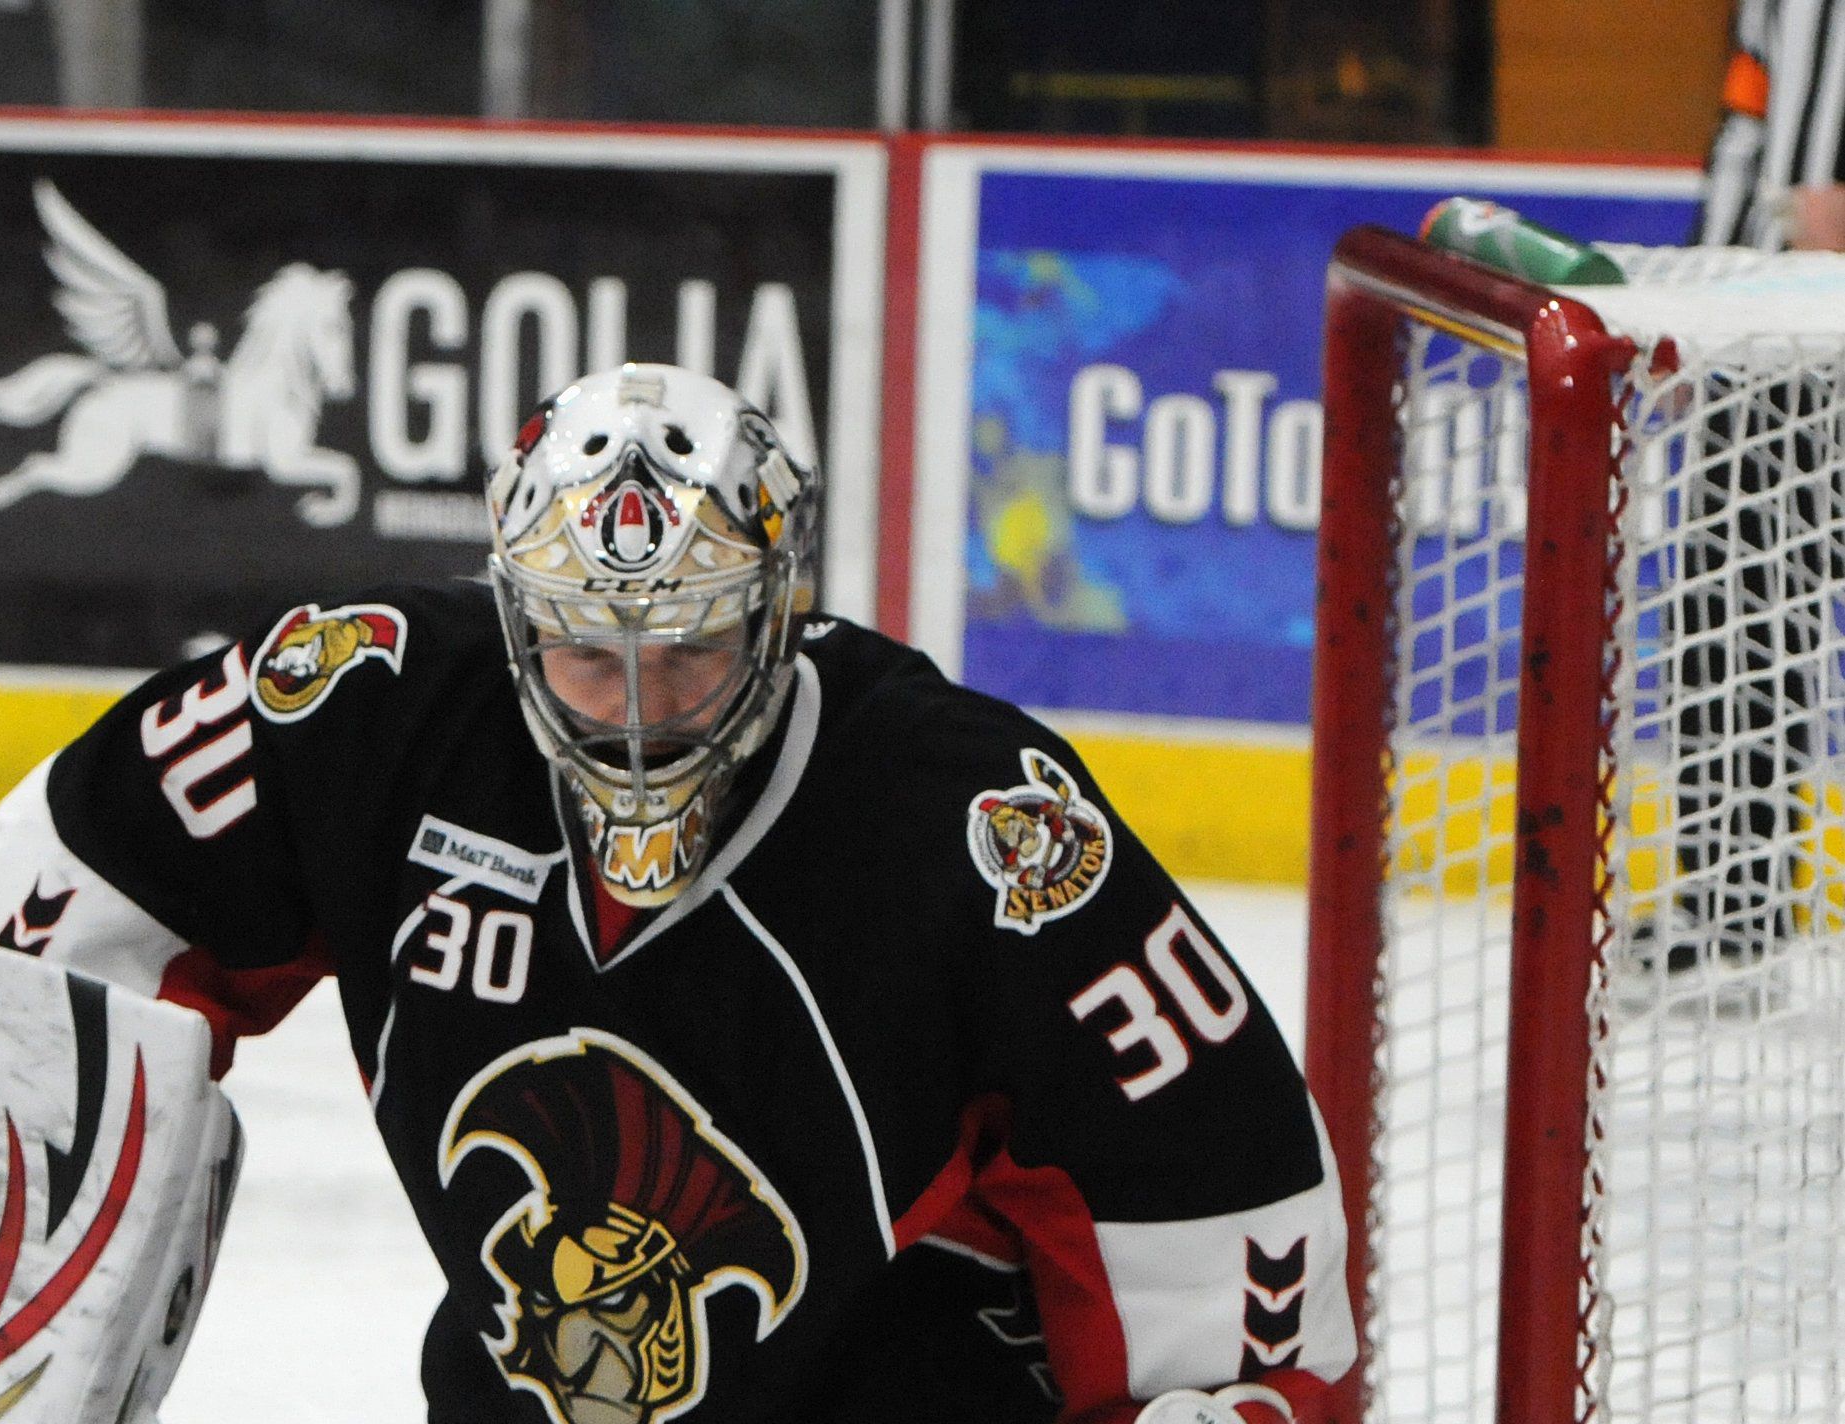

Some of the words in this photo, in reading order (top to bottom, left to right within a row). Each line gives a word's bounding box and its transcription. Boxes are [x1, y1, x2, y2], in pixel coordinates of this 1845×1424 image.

[583, 579, 683, 593] CCM
[139, 640, 258, 841] 30
[489, 855, 538, 887] Bank
[409, 892, 534, 1004] 30
[1067, 901, 1249, 1102] 30
